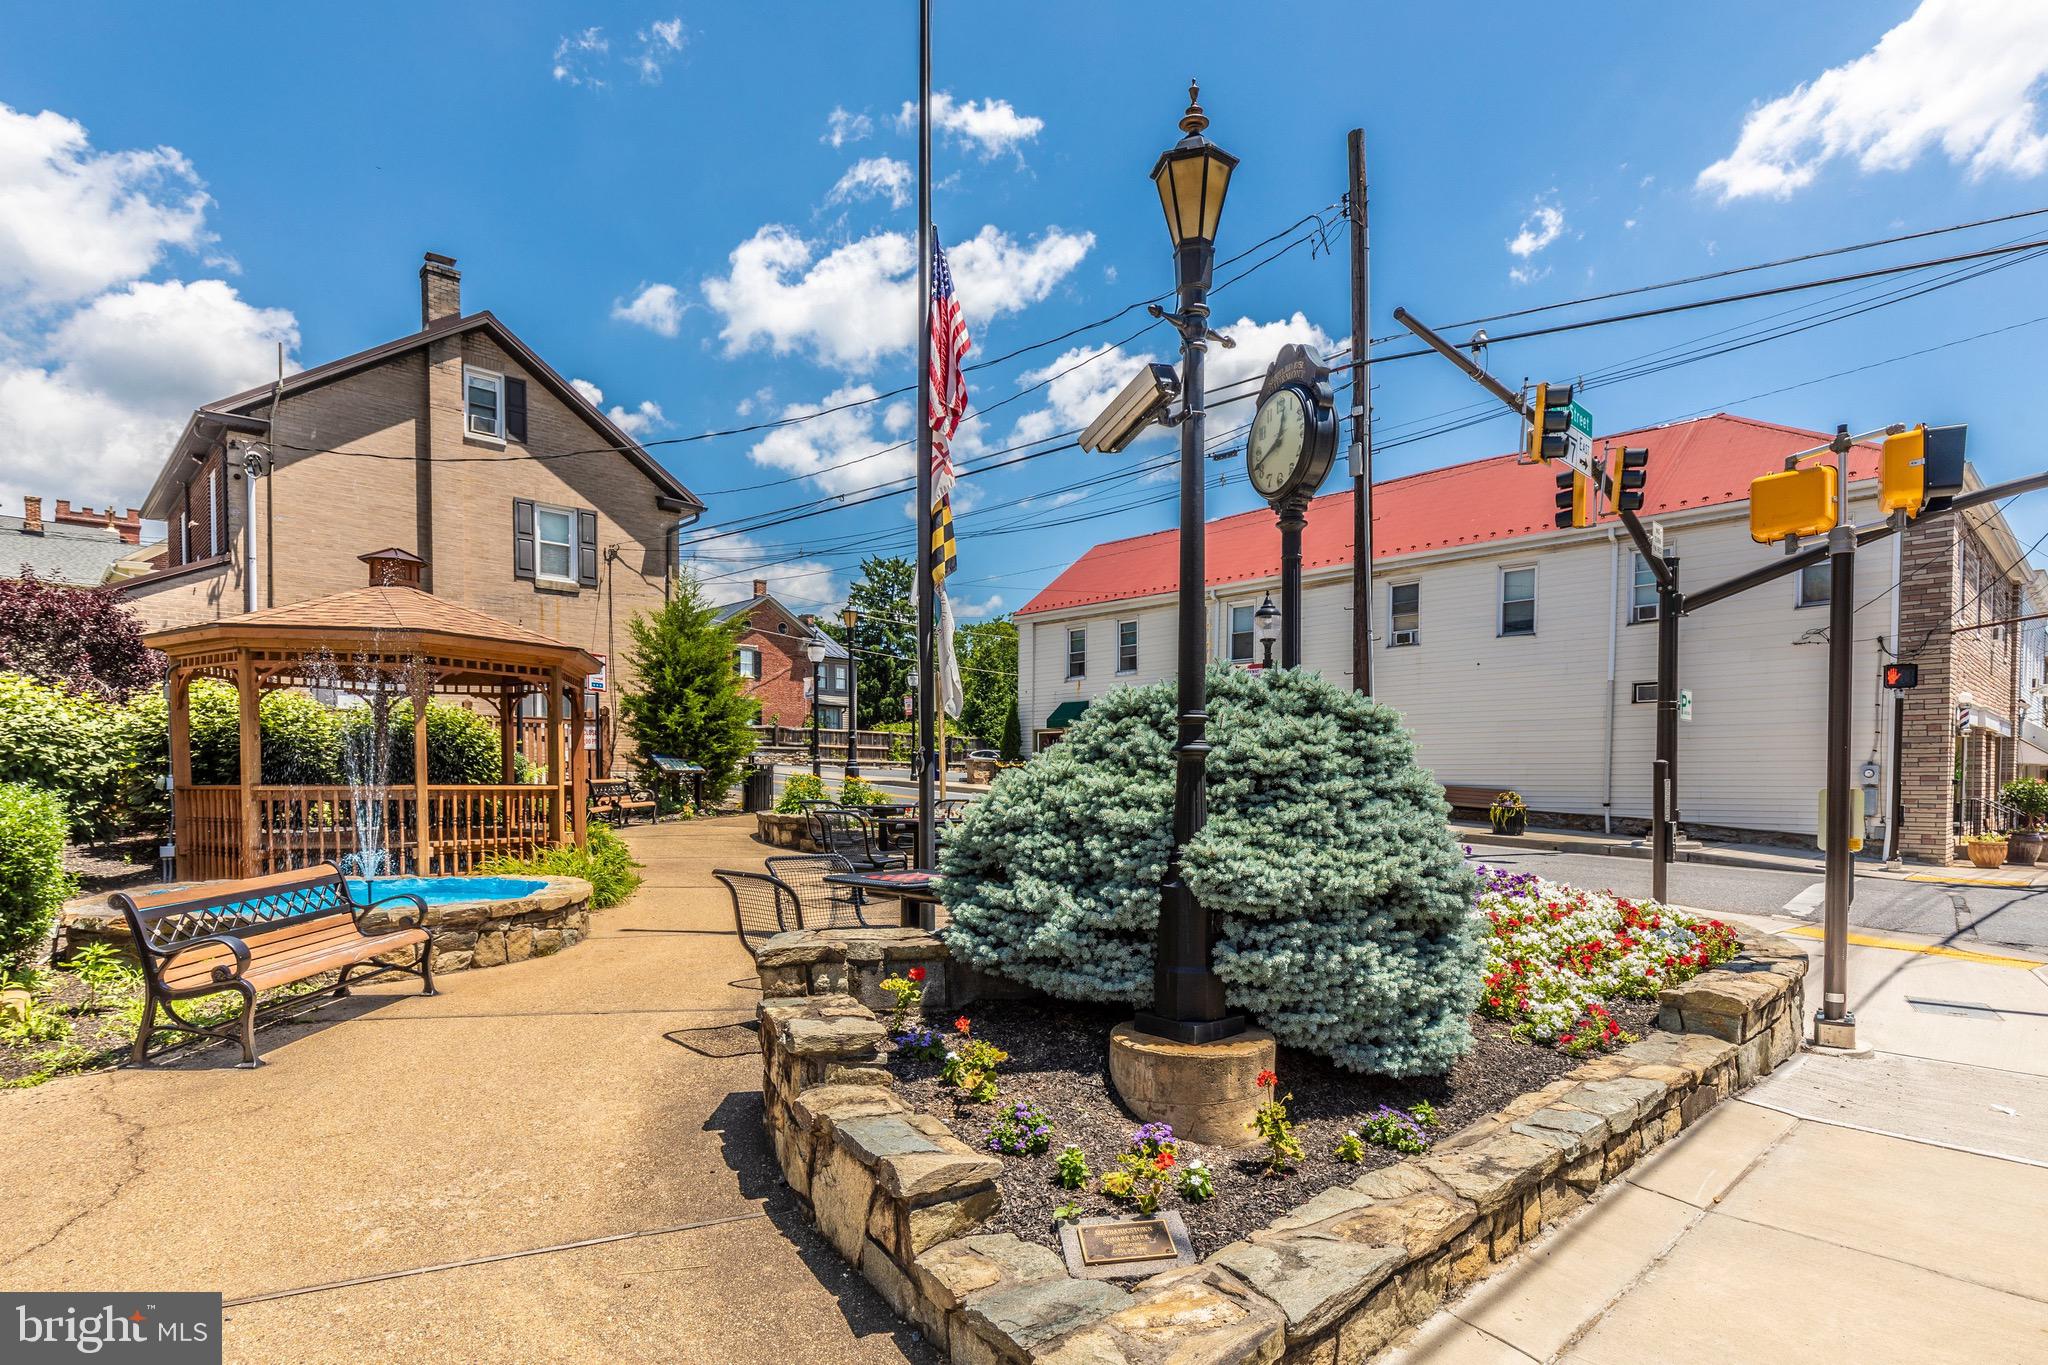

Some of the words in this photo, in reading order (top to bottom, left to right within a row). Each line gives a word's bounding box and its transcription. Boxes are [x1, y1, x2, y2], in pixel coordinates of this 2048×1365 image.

[1570, 404, 1590, 431] Street
[1266, 473, 1272, 488] 7
[1277, 472, 1284, 488] 6
